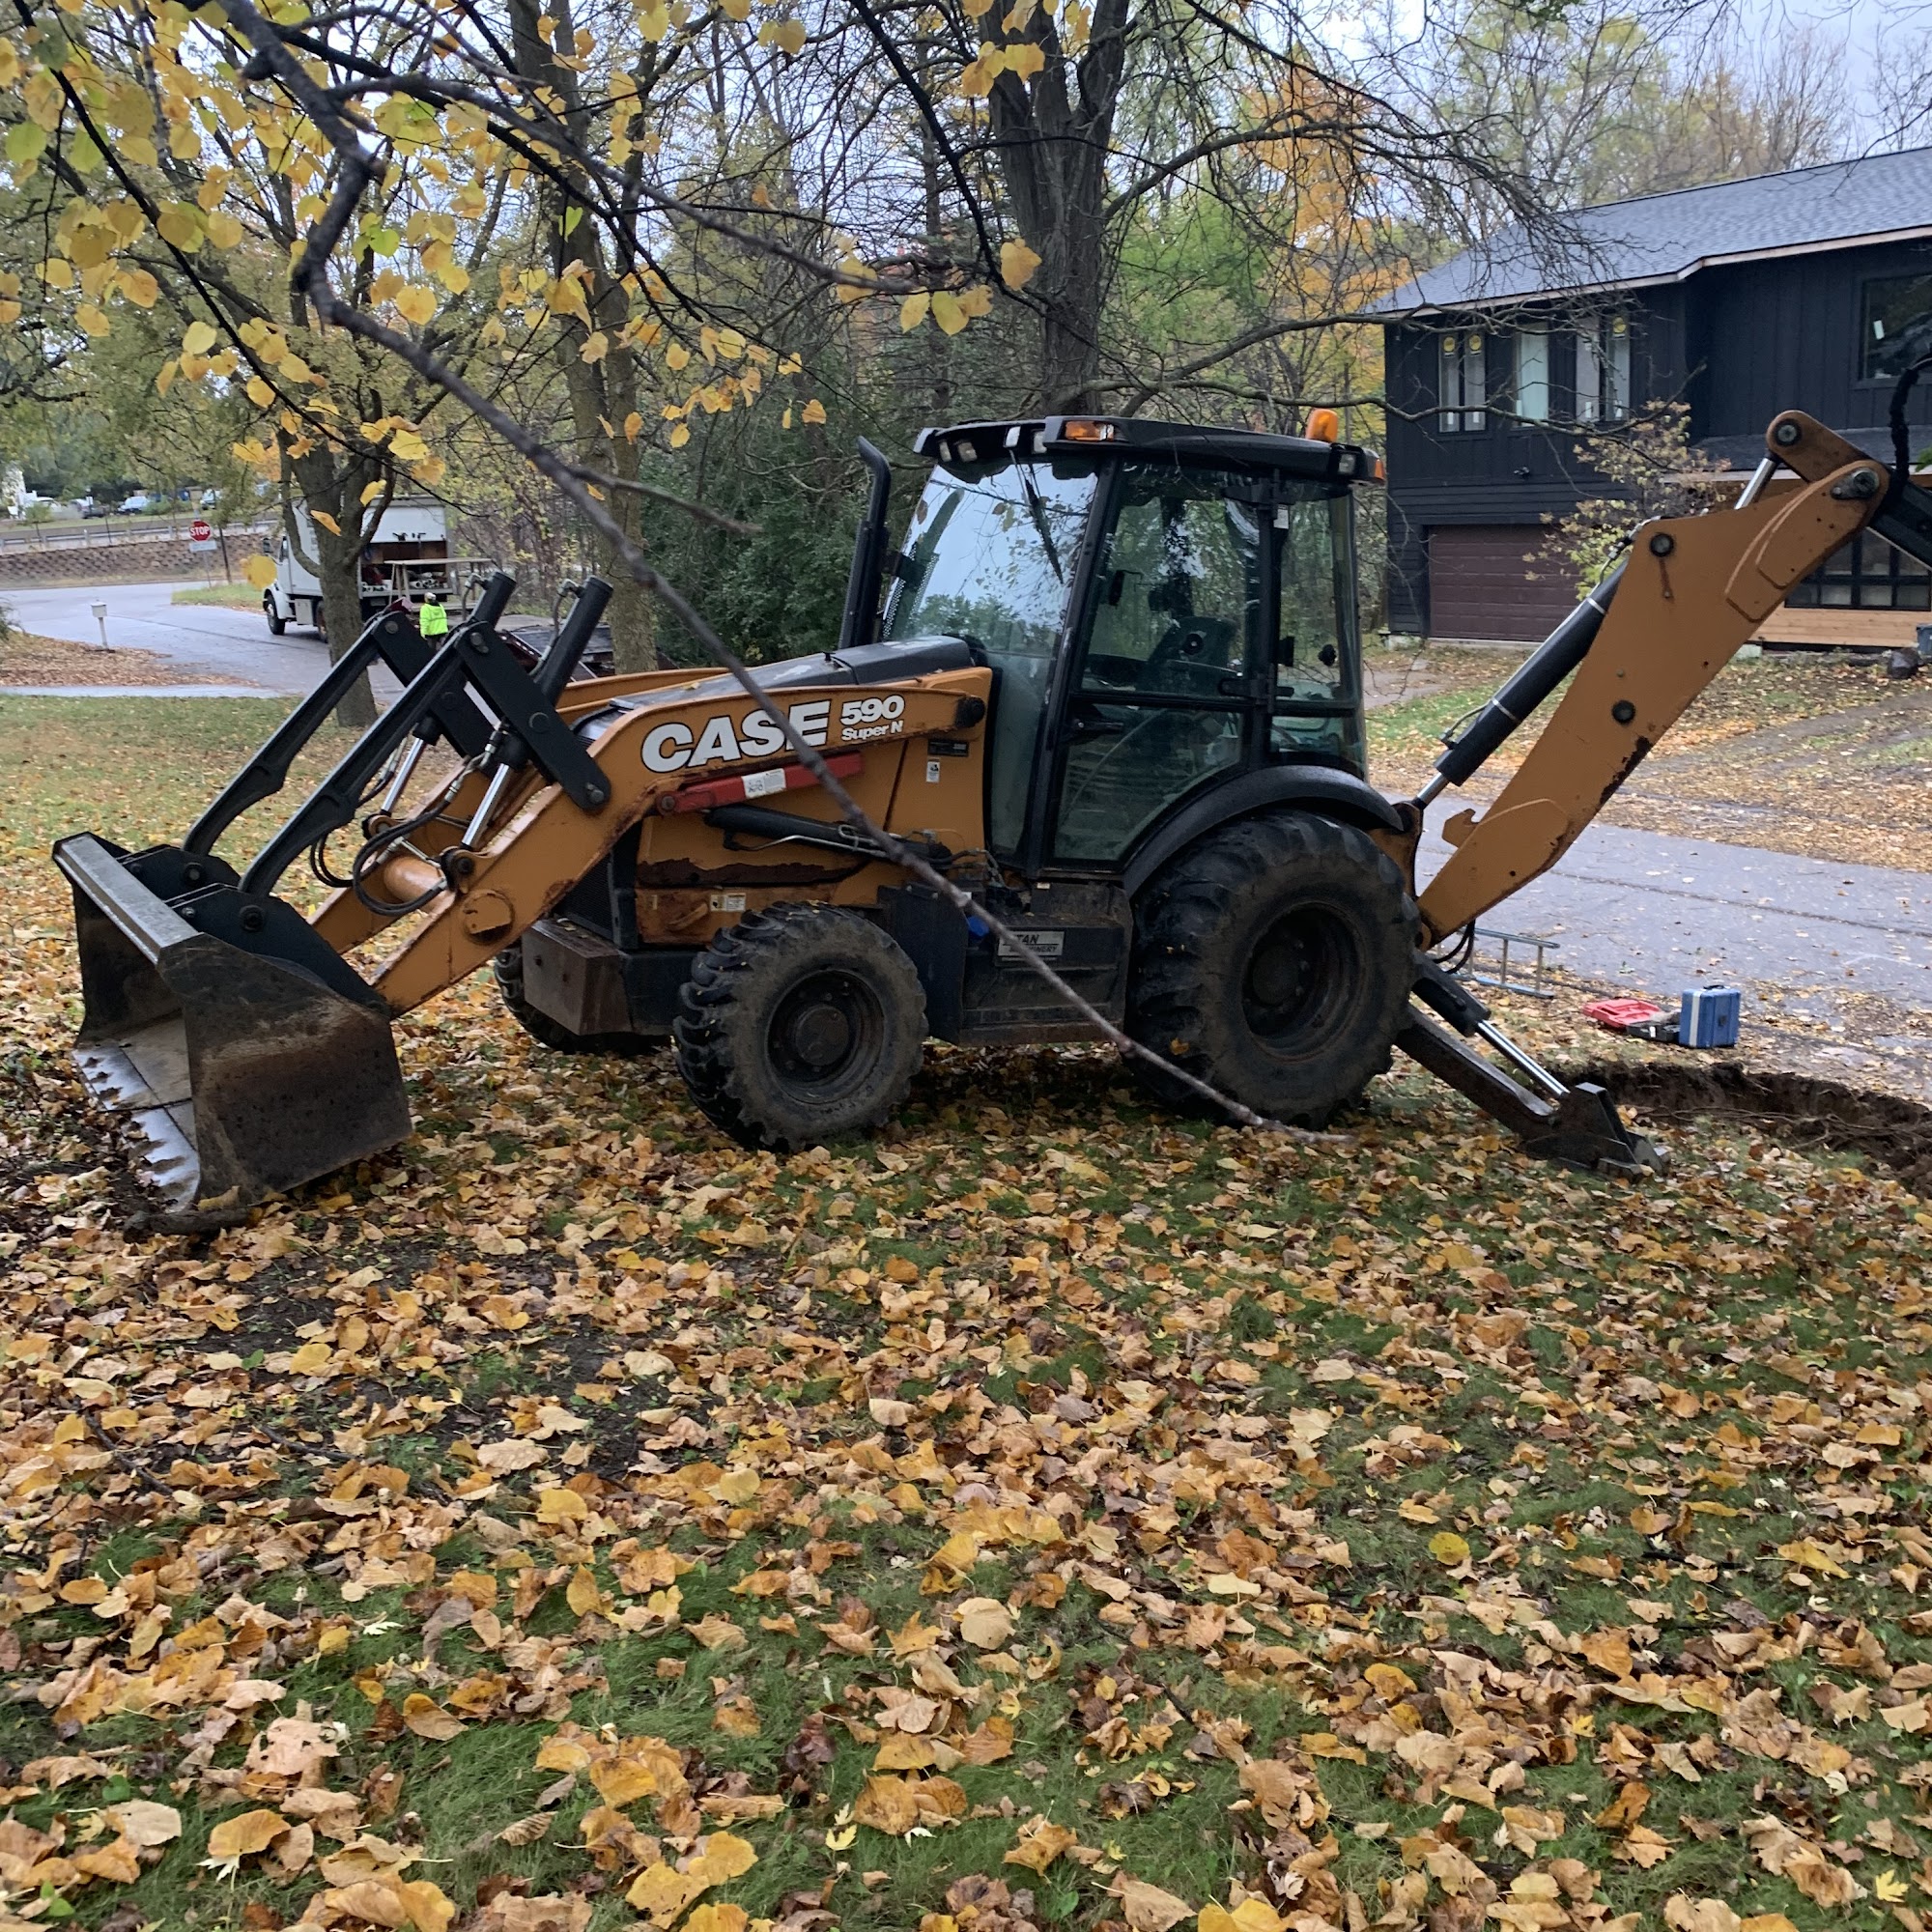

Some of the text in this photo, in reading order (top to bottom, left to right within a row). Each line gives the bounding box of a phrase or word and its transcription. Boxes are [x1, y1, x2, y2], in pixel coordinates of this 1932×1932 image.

[189, 526, 210, 536] STOP
[839, 695, 905, 725] 590
[640, 698, 832, 773] CASE
[841, 720, 904, 741] Super N
